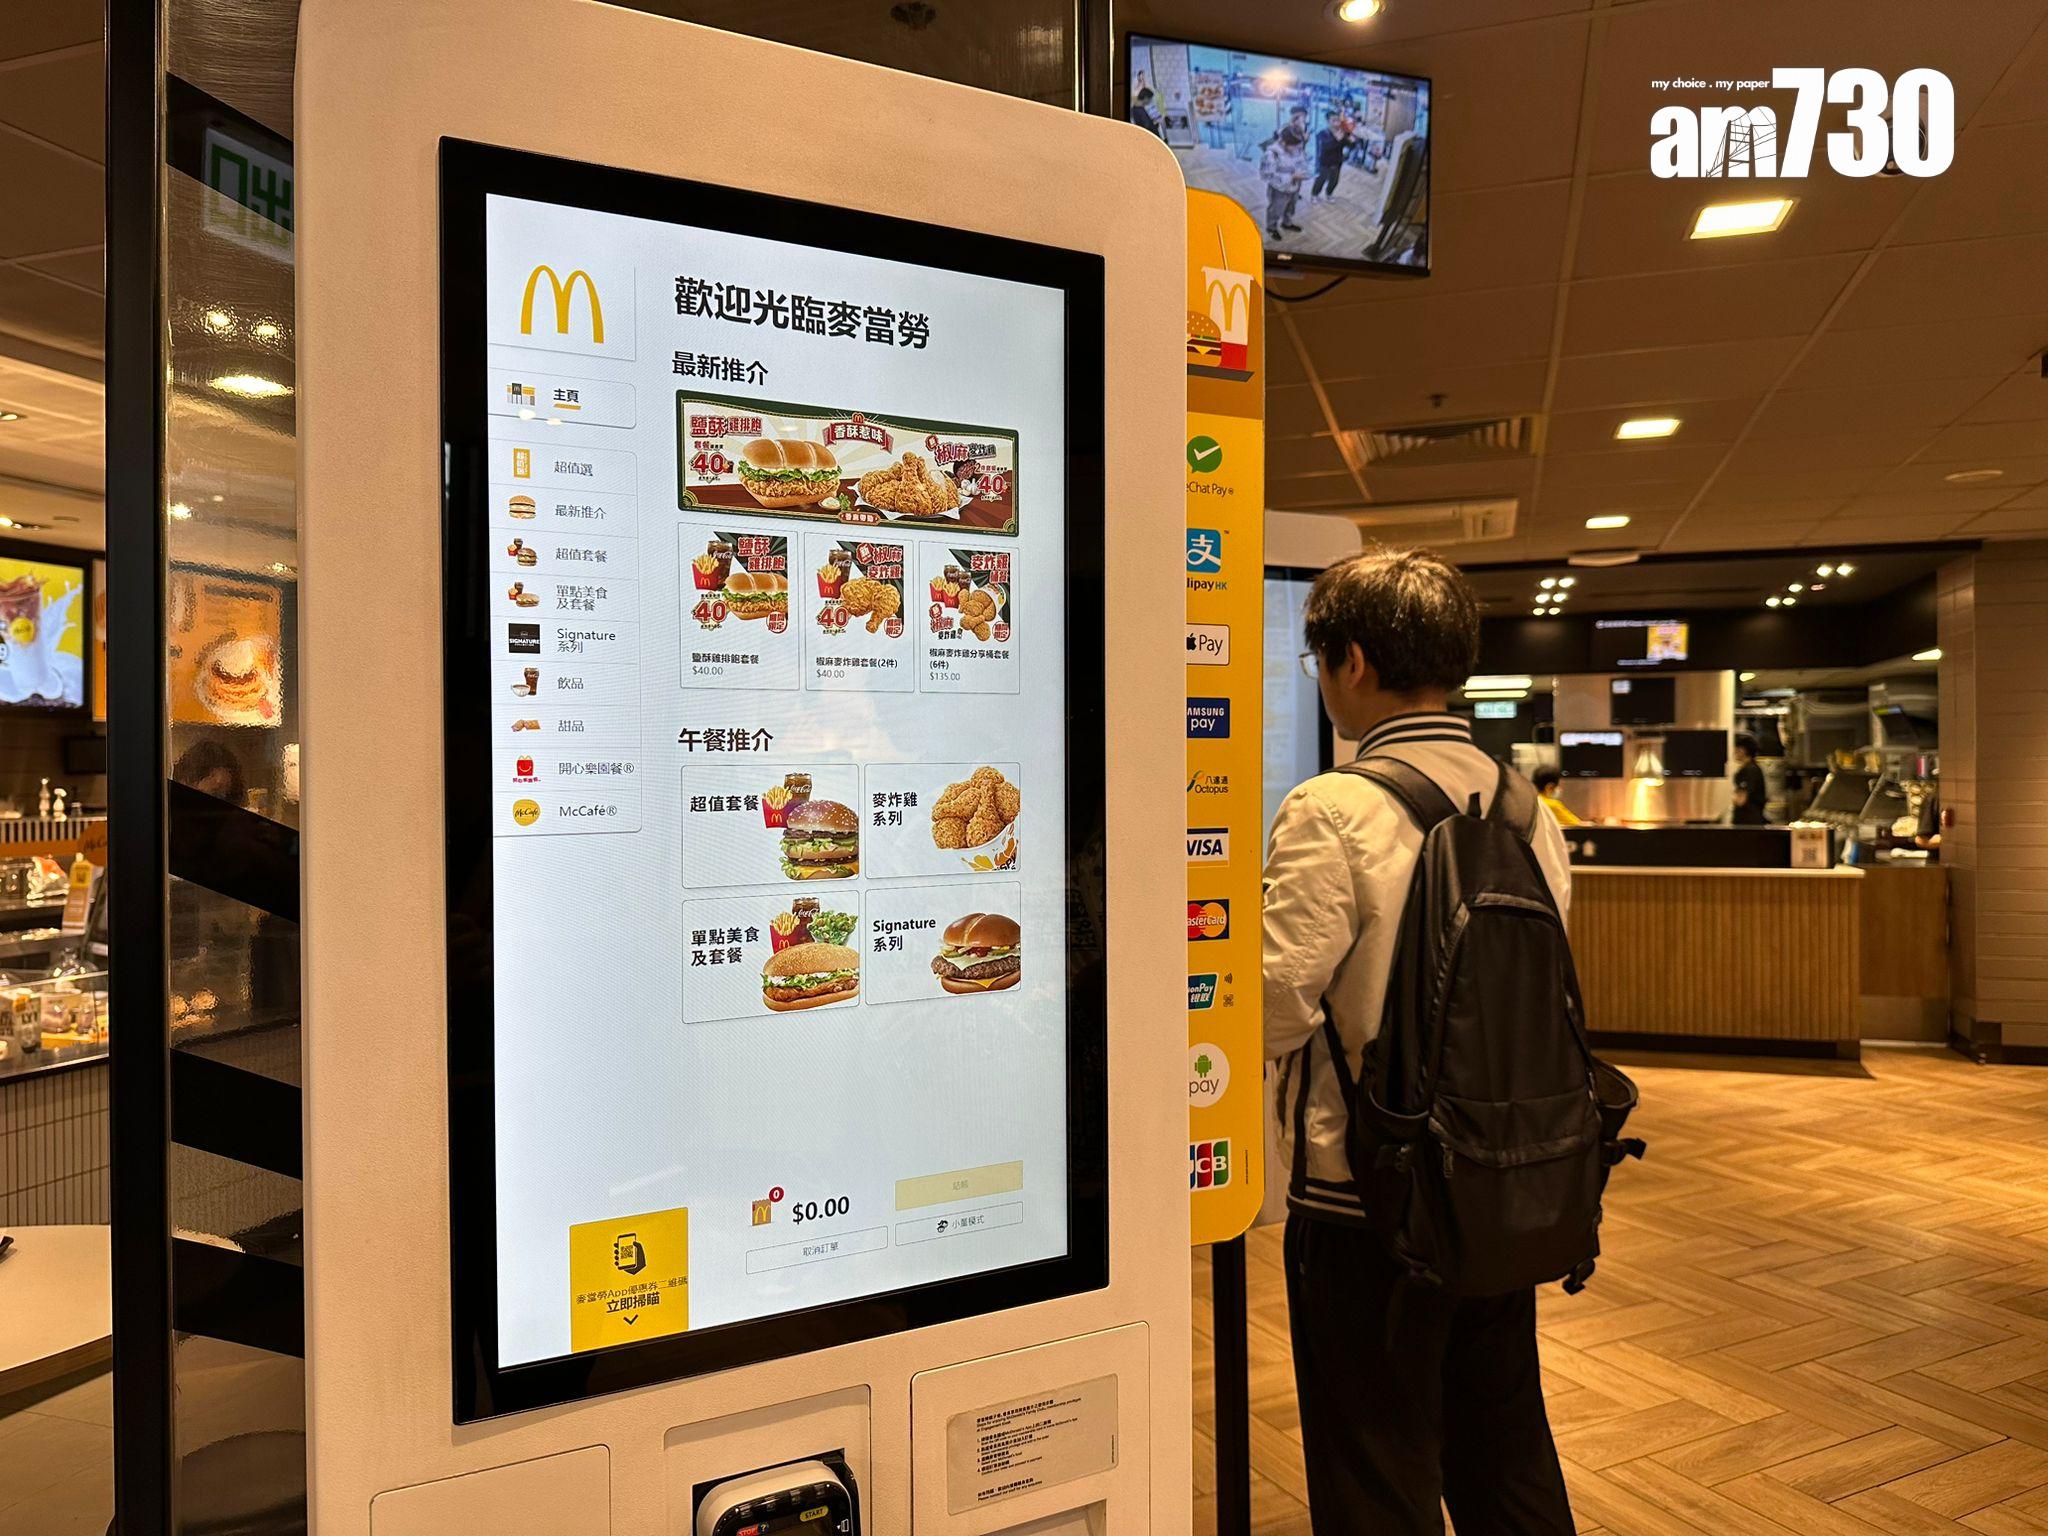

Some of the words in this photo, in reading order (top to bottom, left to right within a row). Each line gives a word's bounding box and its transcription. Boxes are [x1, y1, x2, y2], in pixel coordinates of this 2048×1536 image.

[673, 275, 931, 351] 歡迎光臨麥當勞
[672, 350, 768, 387] 最新推介
[553, 388, 580, 403] 主頁
[554, 460, 594, 477] 超值選
[1211, 482, 1228, 496] Pay
[555, 504, 607, 520] 最新推介
[555, 548, 608, 564] 超值套餐
[1187, 577, 1214, 591] lipay
[556, 585, 608, 600] 單點美食
[556, 598, 596, 612] 及套餐
[557, 628, 616, 643] Signature
[557, 641, 584, 653] 系列
[1198, 634, 1223, 656] Pay
[692, 666, 724, 676] $40.00
[929, 660, 950, 670] (6件)
[816, 669, 845, 679] $40.00
[929, 672, 961, 681] $135.00
[558, 676, 584, 690] 飲品
[1187, 707, 1225, 716] AMSUNG
[558, 719, 585, 732] 甜品
[1191, 718, 1216, 732] pay
[678, 728, 774, 752] 午餐推介
[1194, 784, 1229, 796] Octopus
[689, 795, 759, 813] 超值套餐
[872, 791, 918, 809] 麥炸雞
[559, 805, 618, 817] McCafé®
[872, 809, 903, 827] 系列
[873, 917, 937, 935] Signature
[1187, 915, 1225, 927] asterCard
[691, 926, 760, 947] 單點美食
[873, 935, 903, 953] 系列
[691, 949, 743, 967] 及套餐
[1189, 1078, 1220, 1098] pay
[792, 1195, 850, 1225] $0.00
[606, 1291, 660, 1314] 立即掃瞄
